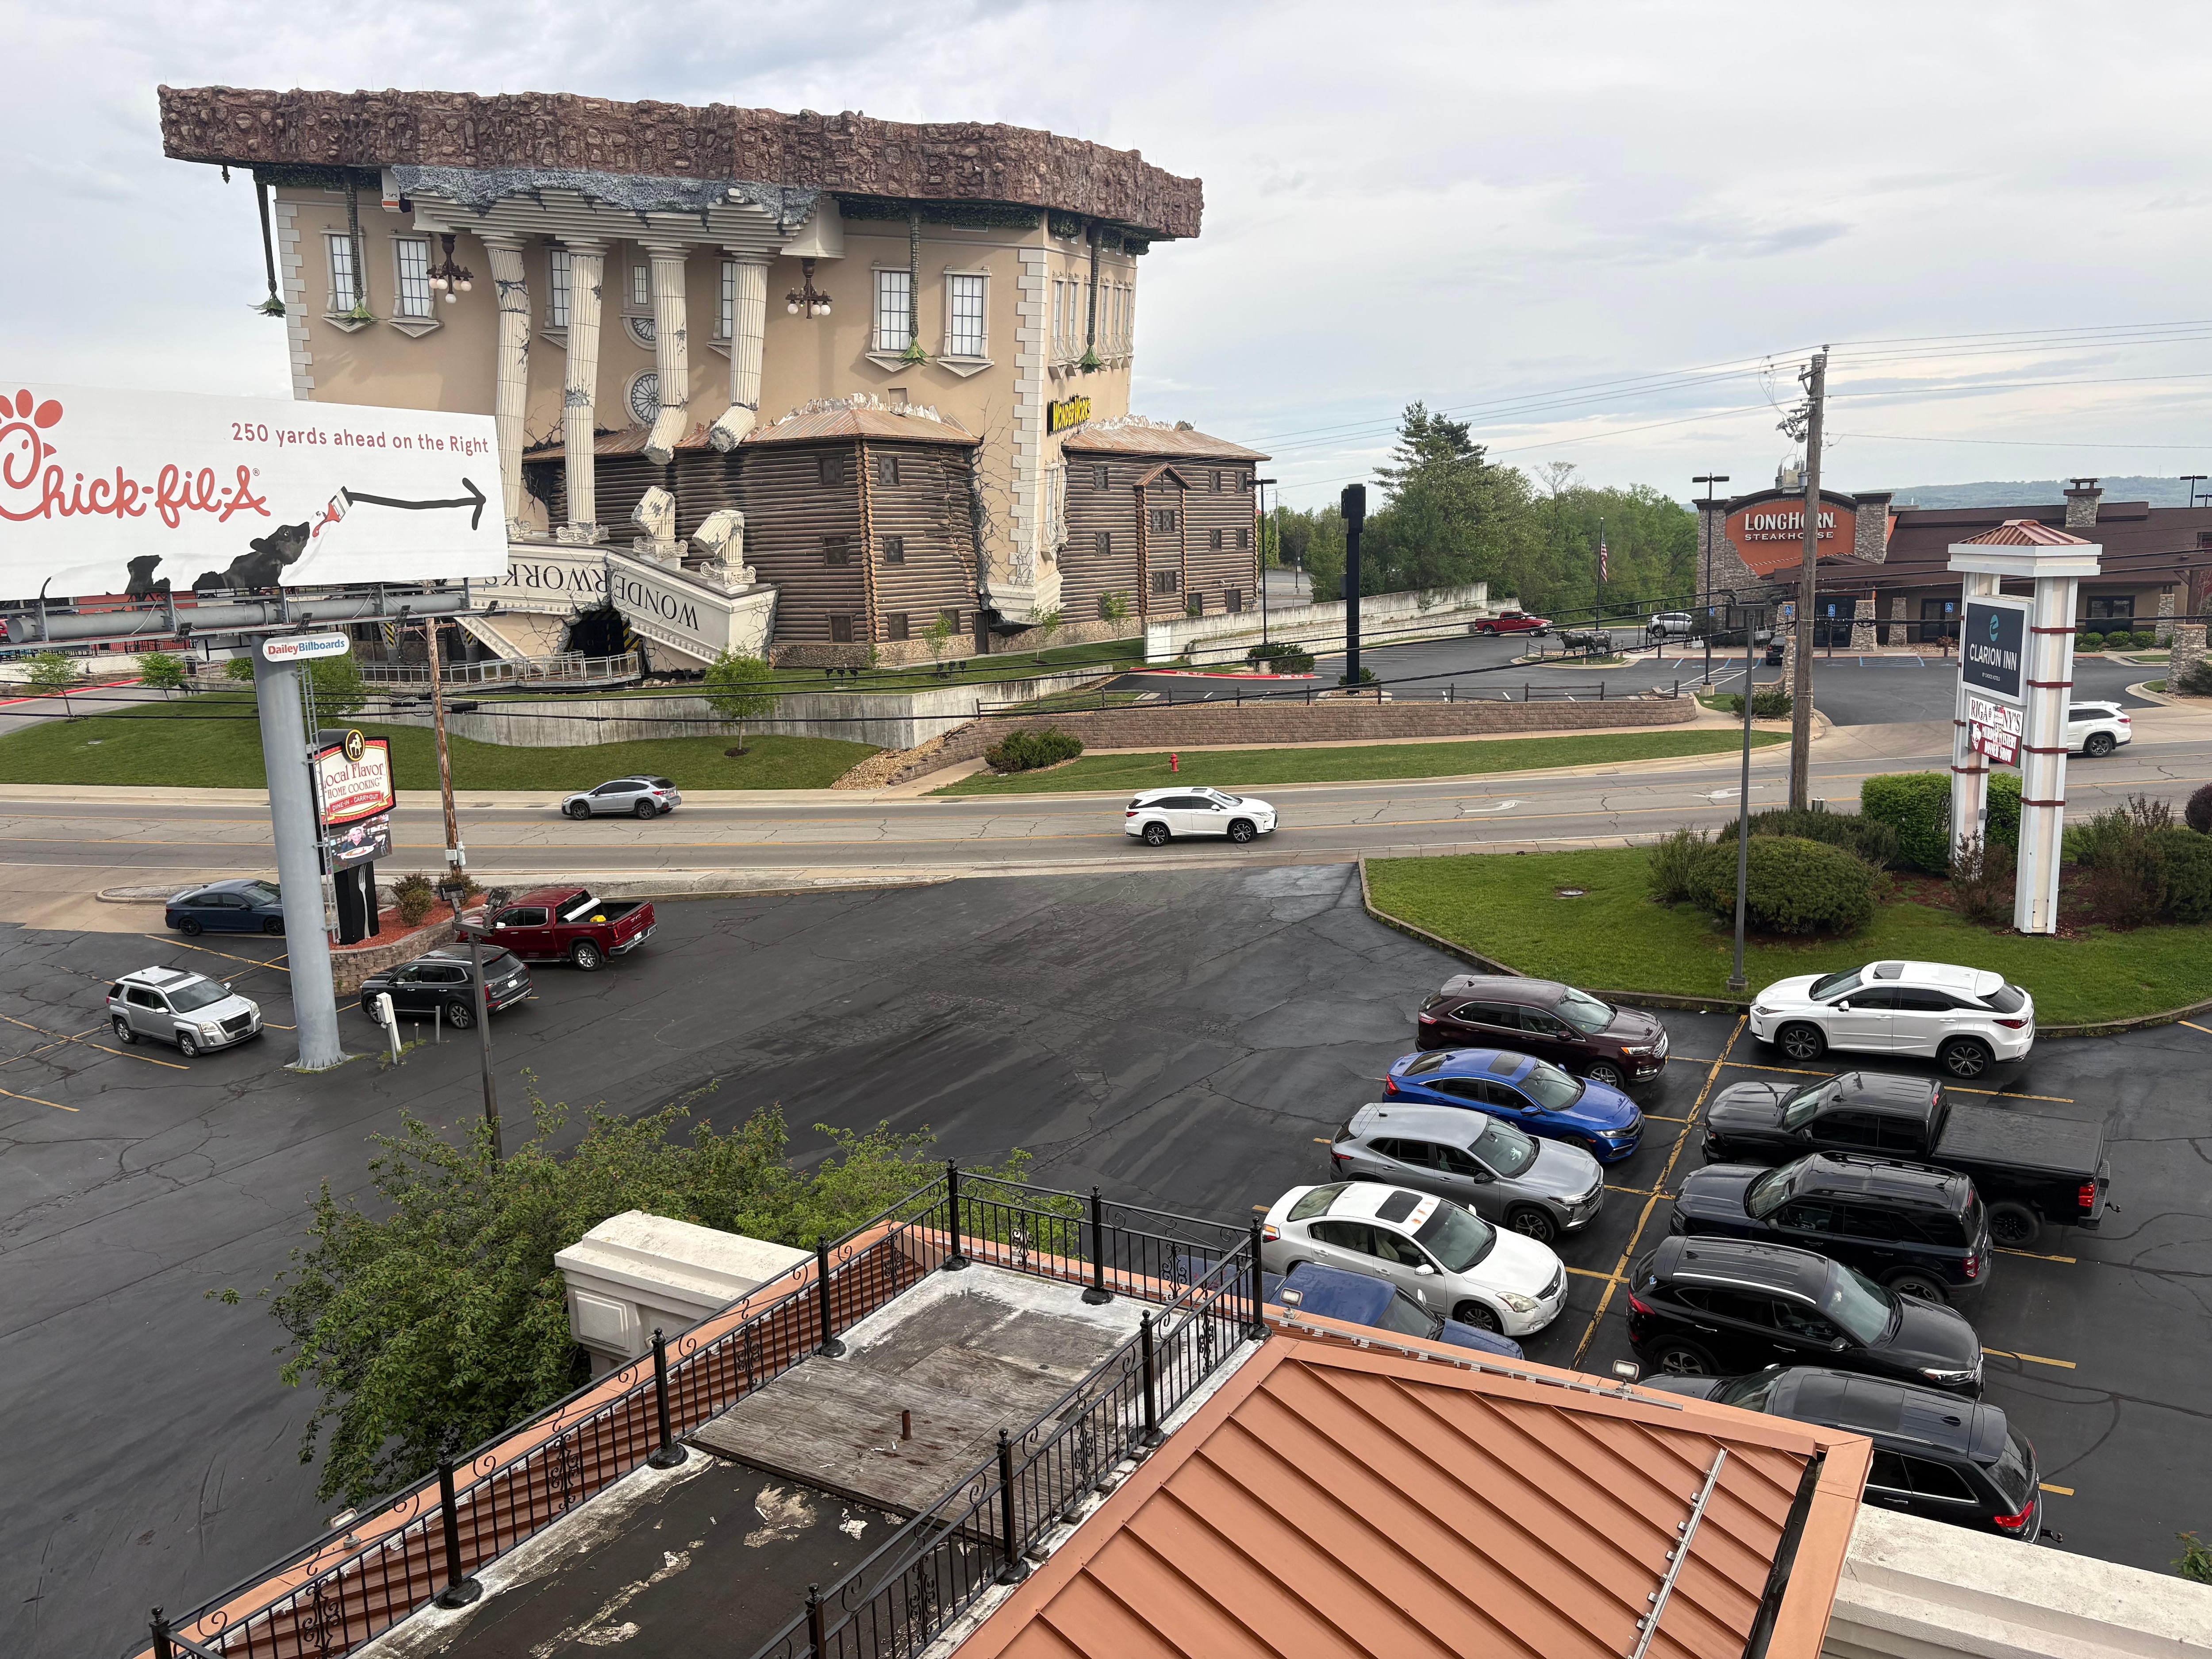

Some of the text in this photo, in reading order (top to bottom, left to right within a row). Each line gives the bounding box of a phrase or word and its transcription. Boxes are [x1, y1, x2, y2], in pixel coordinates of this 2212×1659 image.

[231, 422, 489, 457] 250 yards ahead on the Right
[1745, 512, 1834, 531] LONGHRN
[1745, 531, 1834, 541] STEAKHOSE
[1970, 643, 2017, 671] CLARION INN
[1999, 746, 2012, 763] SHOW
[351, 761, 384, 779] Flavor
[332, 799, 350, 811] DINE-IN
